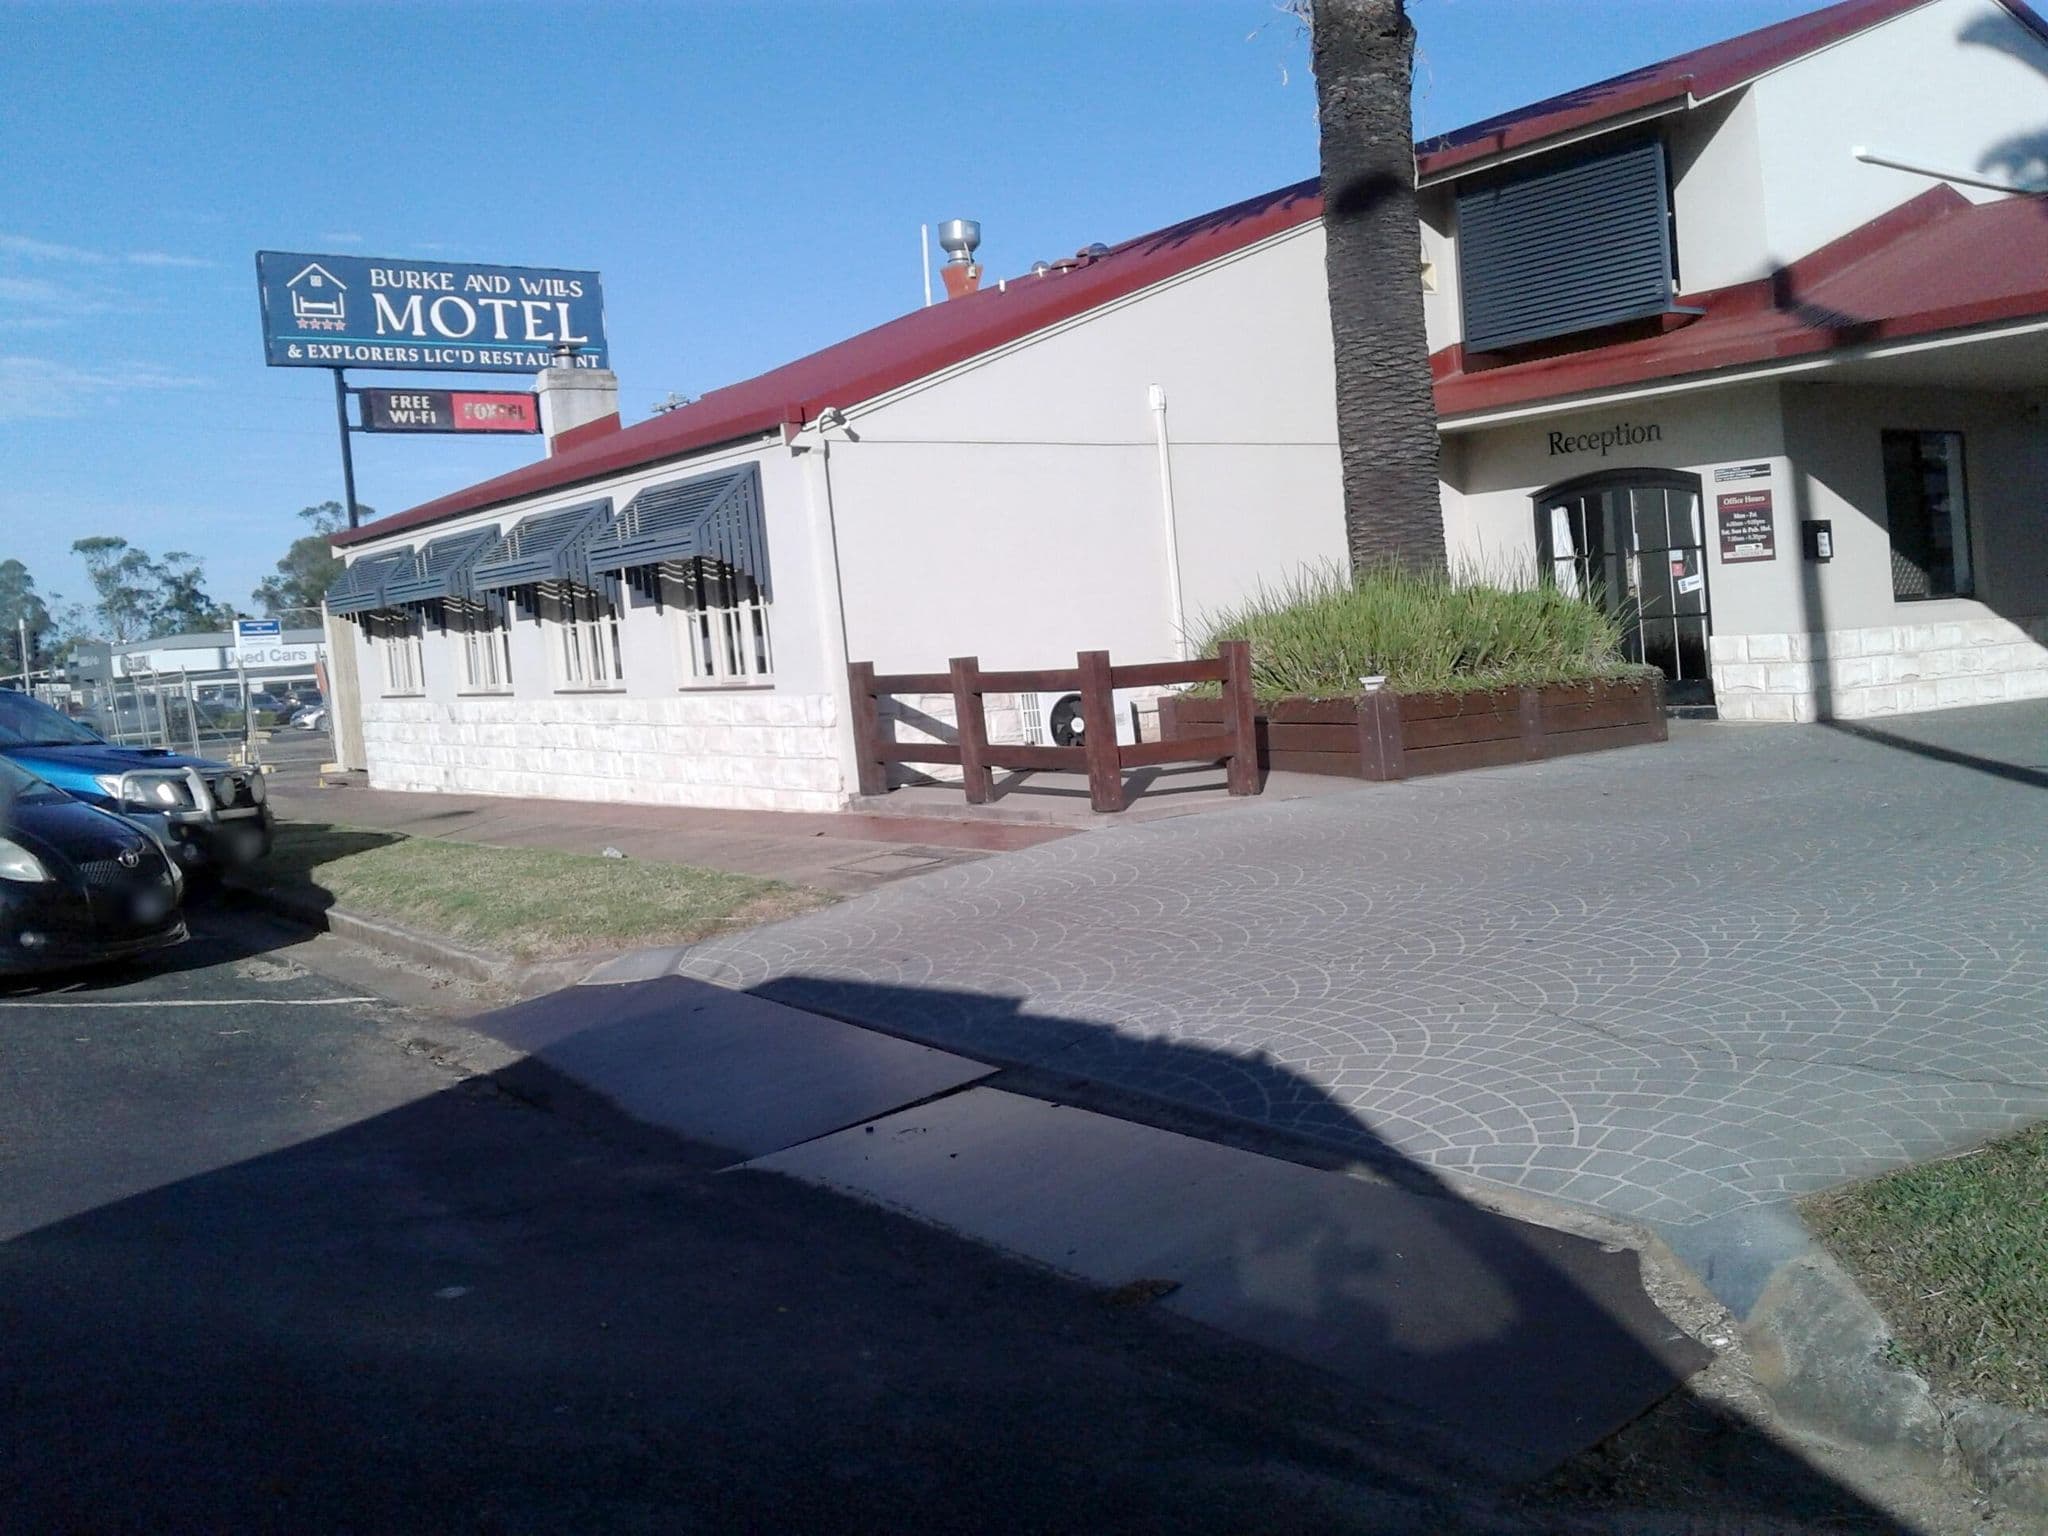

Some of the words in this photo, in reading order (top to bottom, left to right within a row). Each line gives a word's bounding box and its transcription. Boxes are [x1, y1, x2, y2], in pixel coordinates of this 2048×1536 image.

[370, 268, 454, 291] BURKE
[464, 274, 511, 294] AND
[519, 277, 583, 298] WILLS
[371, 293, 588, 343] MOTEL
[287, 344, 302, 358] &
[307, 344, 419, 362] EXPLORERS
[424, 349, 475, 364] LIC'D
[390, 395, 430, 409] FREE
[389, 410, 436, 424] WI-FI
[1548, 422, 1662, 456] Reception
[269, 648, 307, 662] Cars
